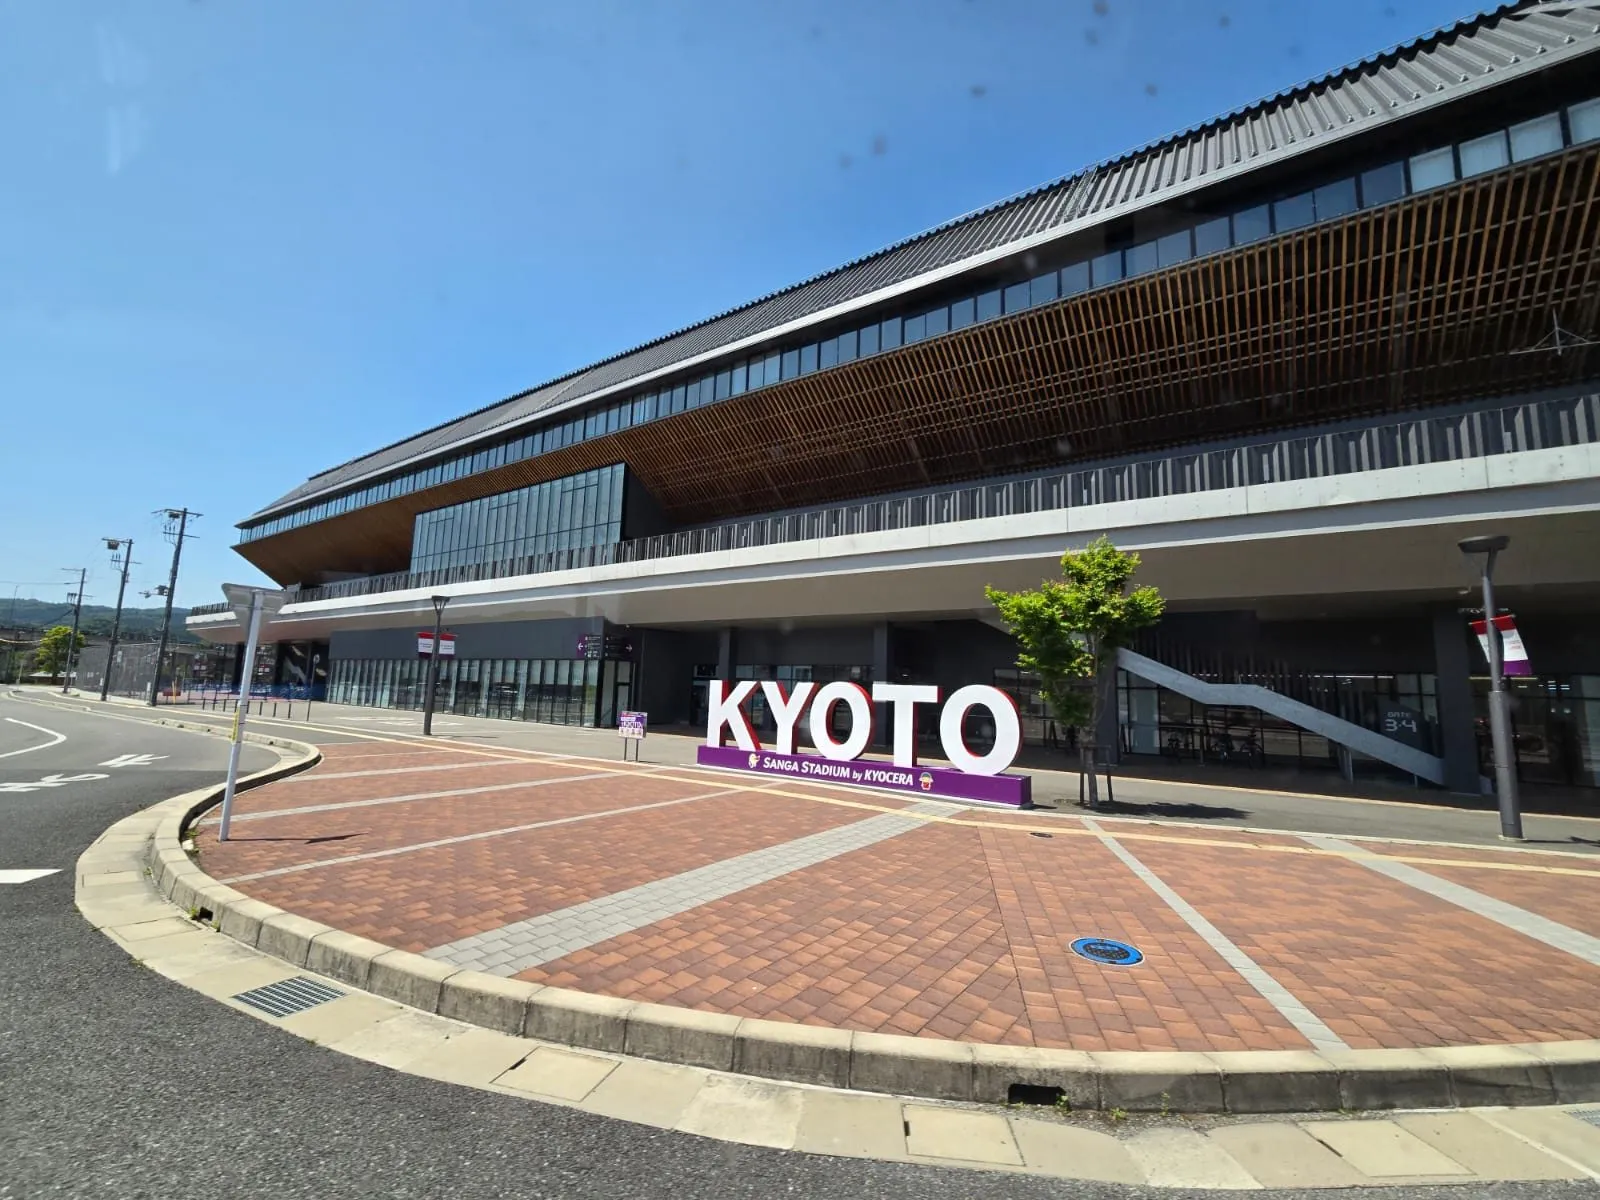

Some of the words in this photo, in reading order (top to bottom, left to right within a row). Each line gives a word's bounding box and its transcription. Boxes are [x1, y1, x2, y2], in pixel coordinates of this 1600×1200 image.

[706, 680, 1022, 776] KYOTO
[763, 757, 799, 772] SANGA
[801, 761, 850, 779] STADIUM
[852, 770, 863, 782] by
[864, 769, 914, 786] KYOCERA
